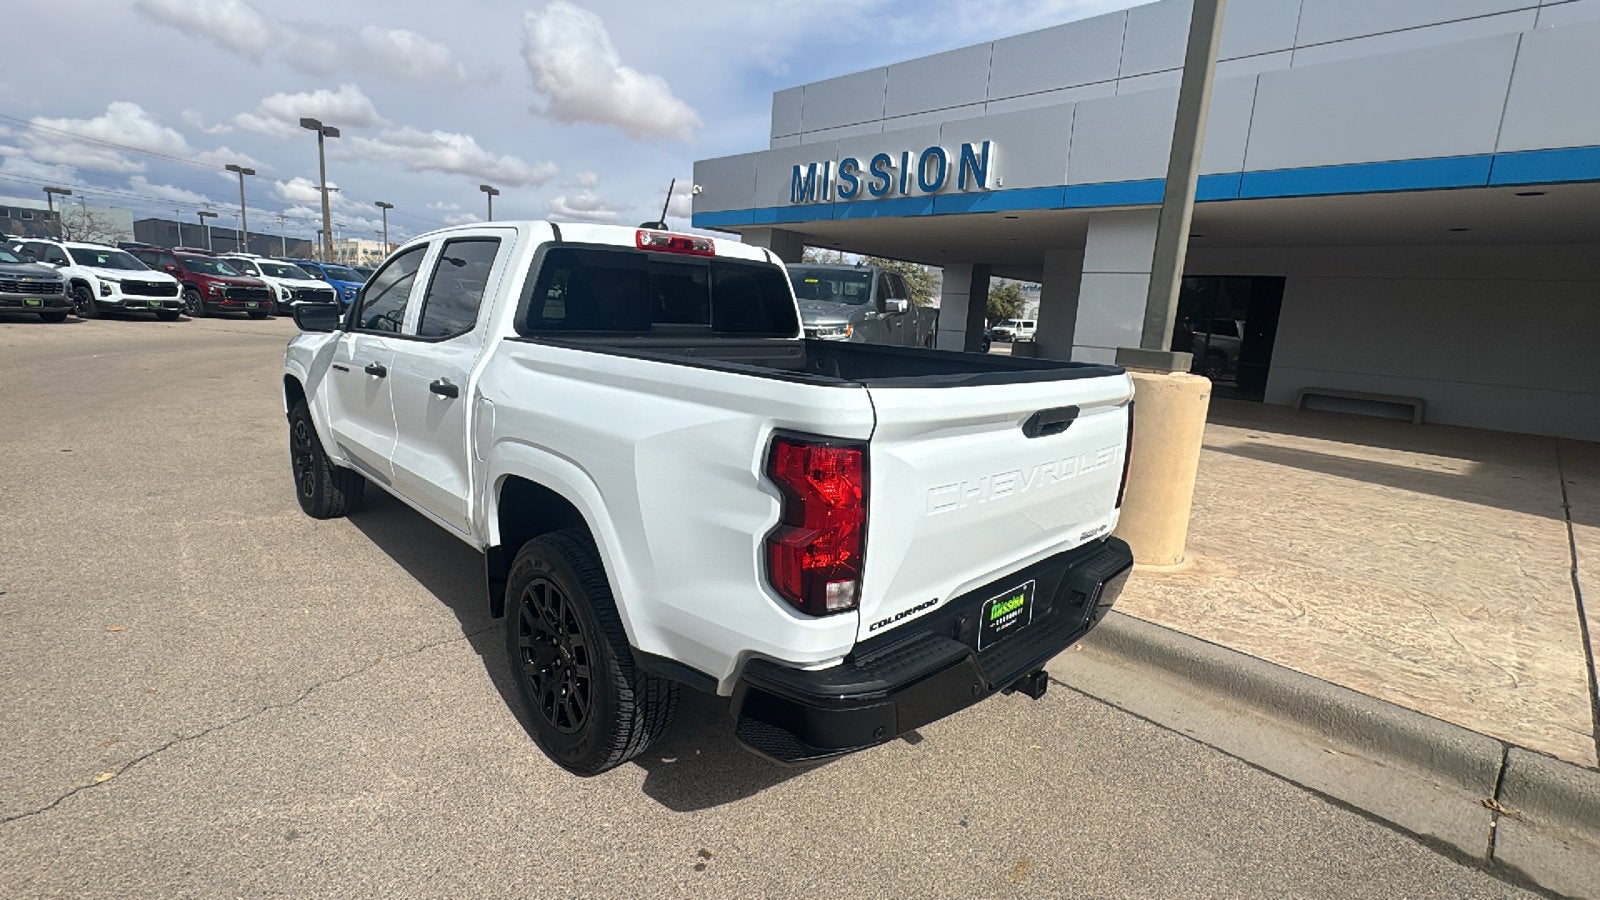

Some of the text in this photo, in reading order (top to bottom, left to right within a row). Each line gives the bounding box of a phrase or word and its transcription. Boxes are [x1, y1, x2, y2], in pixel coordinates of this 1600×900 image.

[790, 140, 994, 203] MISSION
[926, 443, 1122, 515] CHEVROLET
[869, 598, 939, 632] COLORADO
